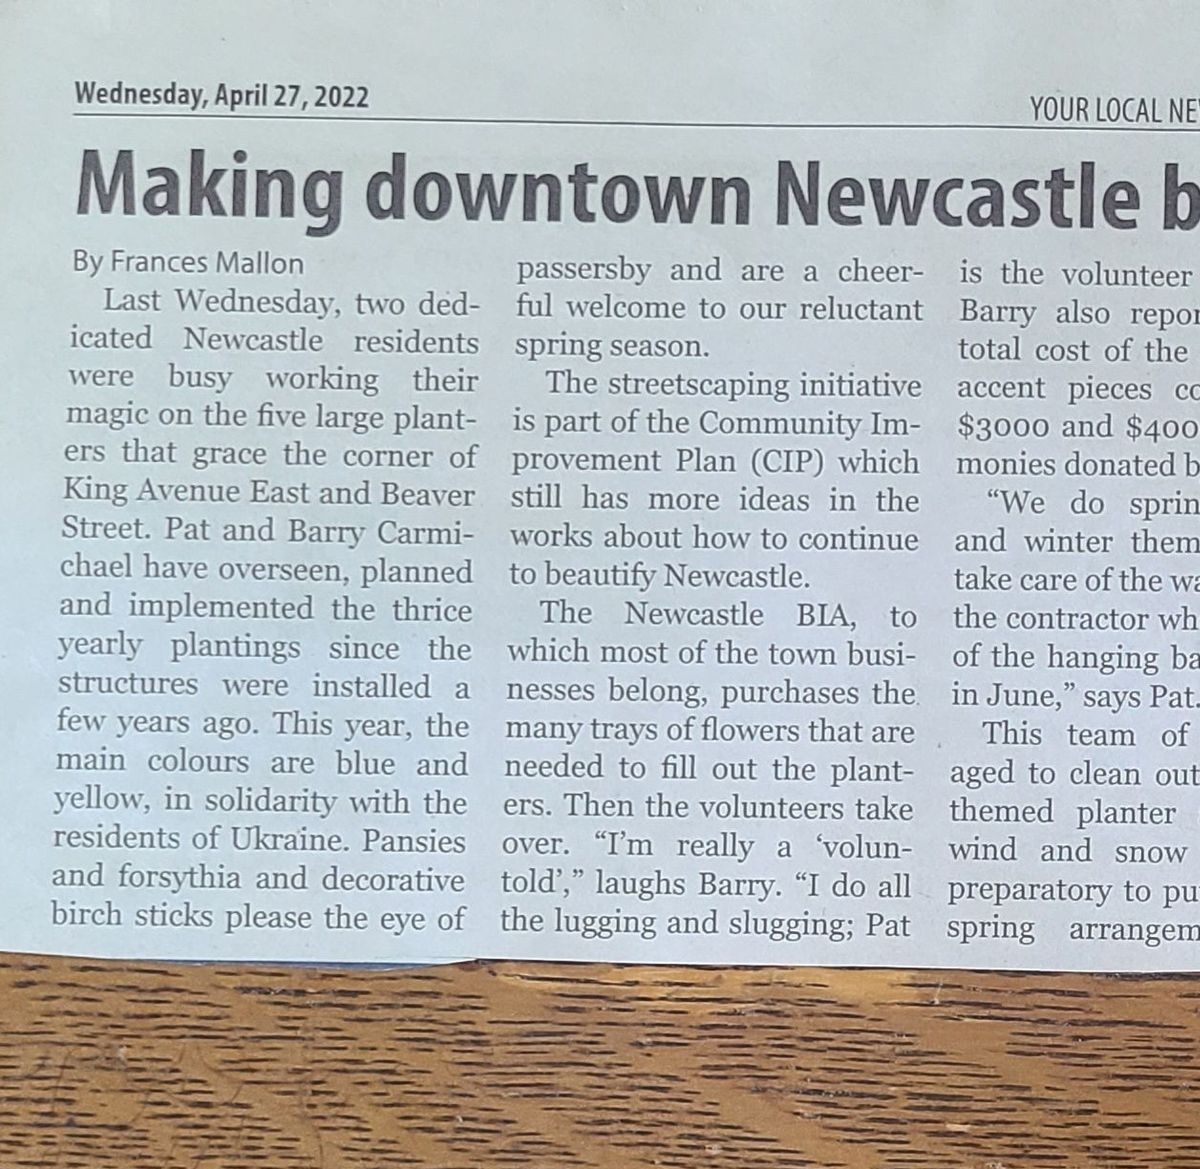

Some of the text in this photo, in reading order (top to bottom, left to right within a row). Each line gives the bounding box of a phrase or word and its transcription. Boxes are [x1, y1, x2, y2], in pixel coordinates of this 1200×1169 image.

[75, 81, 368, 112] Wednesday, April 27, 2022
[1030, 96, 1089, 122] YOUR
[1097, 97, 1163, 123] LOCAL
[77, 149, 343, 237] Making
[366, 152, 750, 225] downtown
[776, 160, 1140, 230] Newcastle
[74, 249, 303, 277] By Frances Mallon
[104, 288, 480, 320] Last Wednesday, two ded-
[960, 298, 1037, 329] Barry
[1056, 299, 1110, 324] also
[71, 324, 479, 354] icated Newcastle residents
[545, 369, 921, 402] The streetscaping initiative
[958, 411, 1049, 441] $3000
[1062, 413, 1114, 438] and
[512, 447, 920, 478] provement Plan (CIP) which
[64, 475, 475, 507] King Avenue East and Beaver
[540, 599, 916, 631] The Newcastle BIA, to
[949, 796, 1054, 823] themed
[1076, 798, 1176, 830] planter
[54, 823, 465, 853] residents of Ukraine. Pansies
[52, 862, 464, 894] and forsythia and decorative
[501, 906, 911, 942] the lugging and slugging; Pat
[947, 914, 1035, 945] spring
